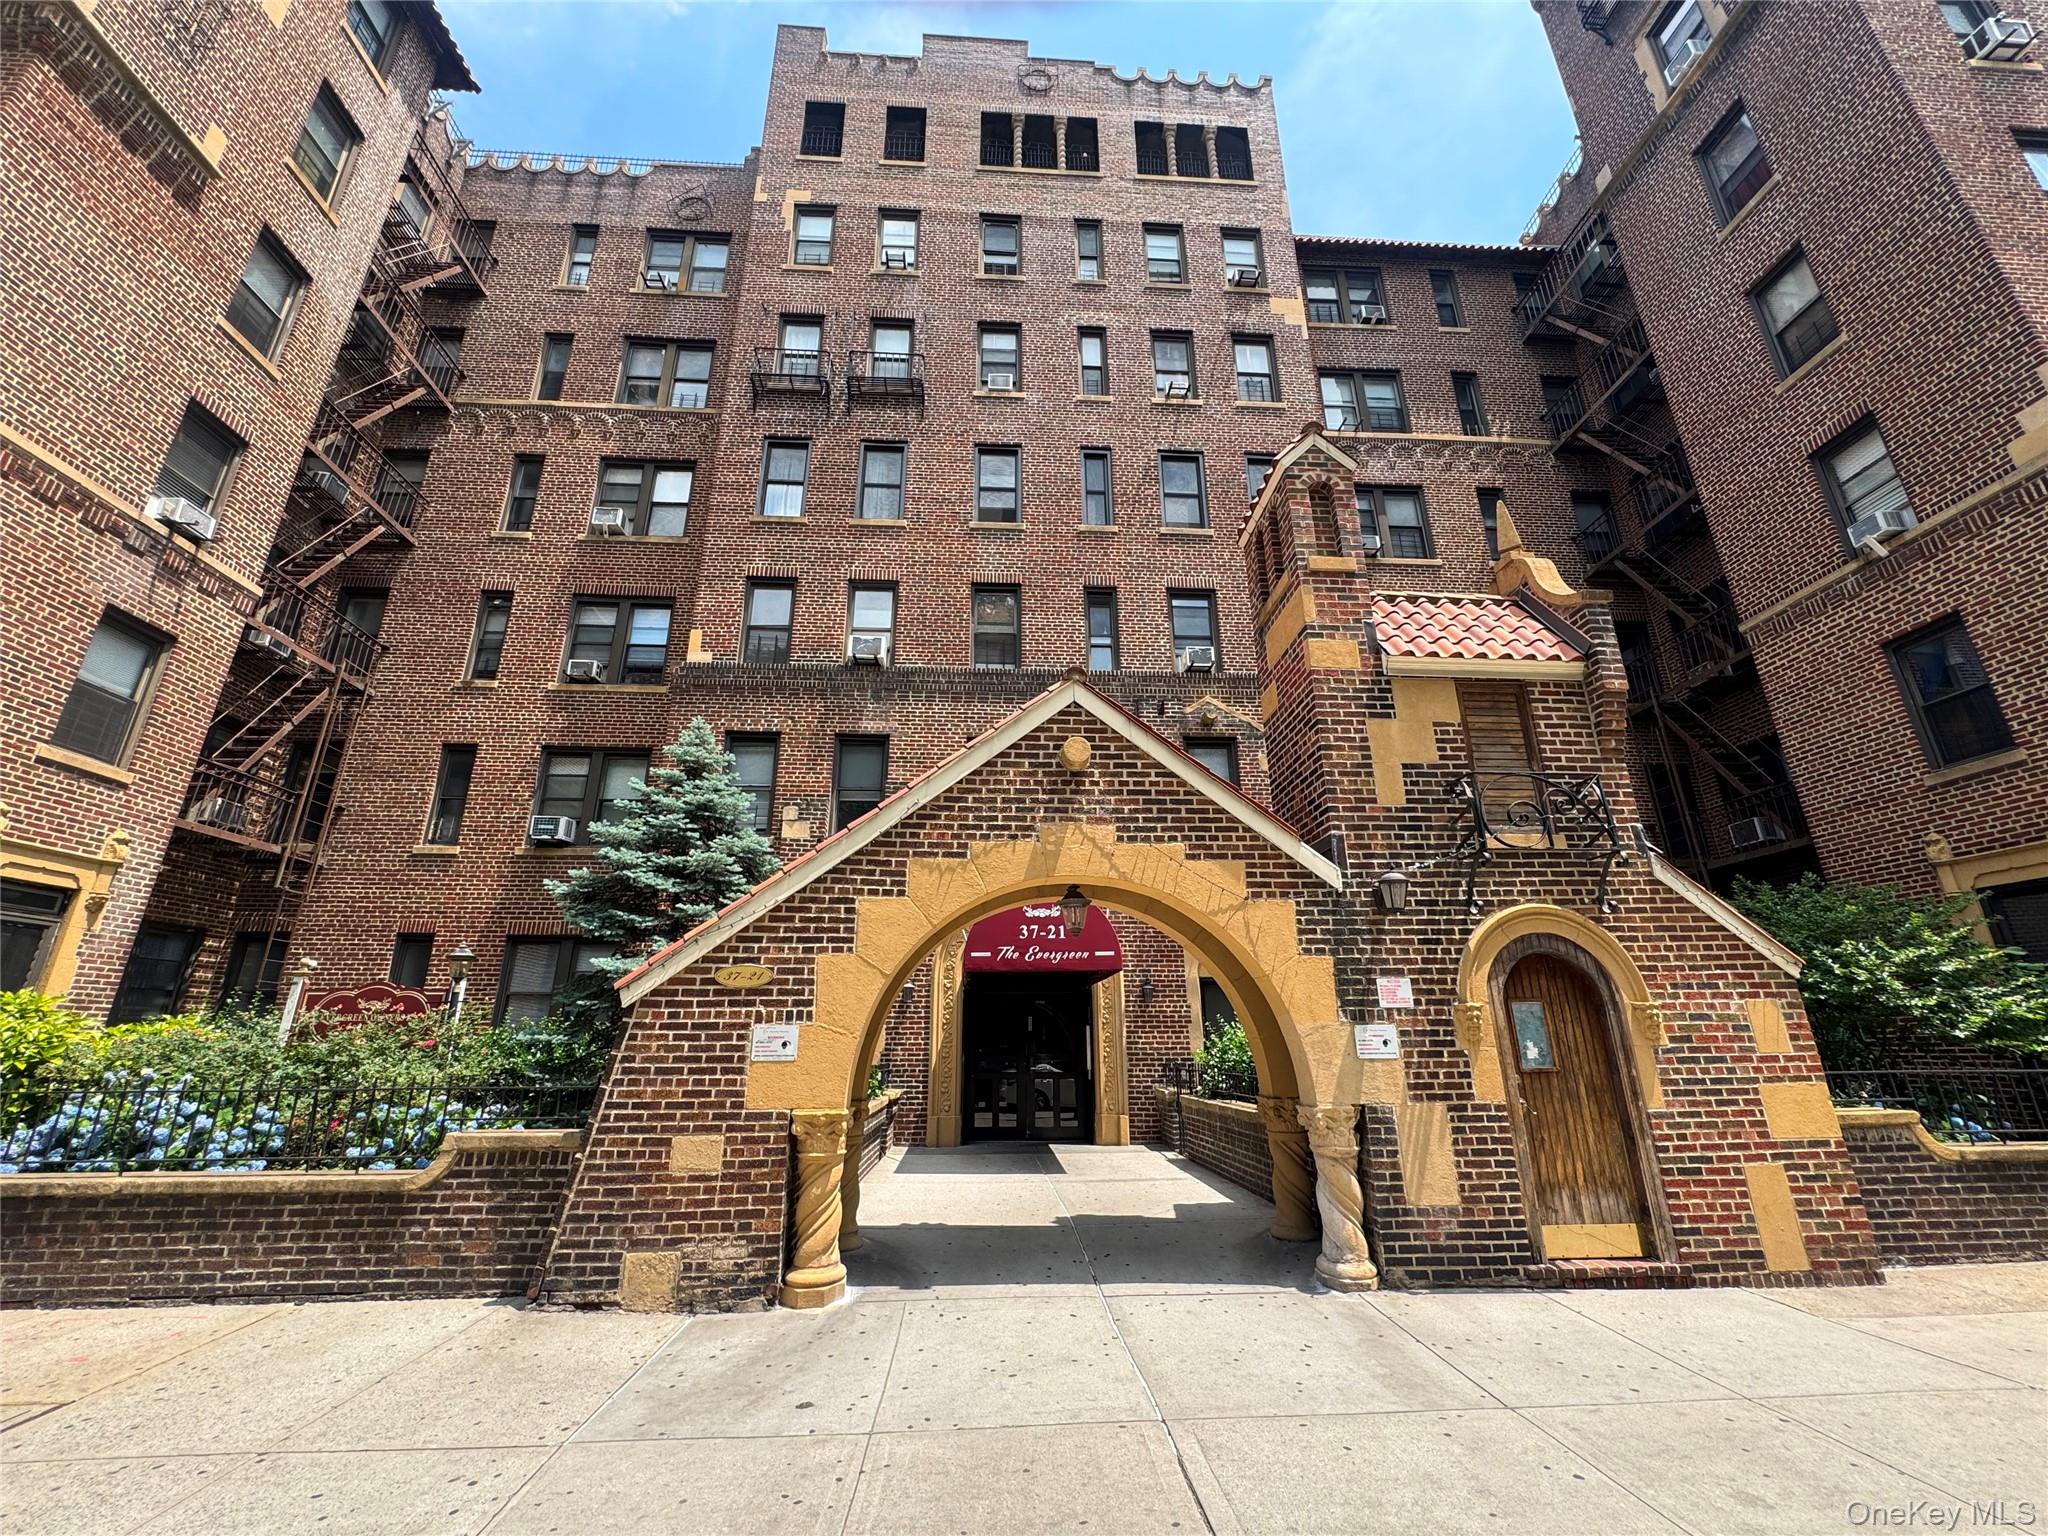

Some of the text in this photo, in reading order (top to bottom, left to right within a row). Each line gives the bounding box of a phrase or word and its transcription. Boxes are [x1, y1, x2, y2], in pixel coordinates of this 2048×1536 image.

[1019, 925, 1066, 939] 37-21
[996, 945, 1090, 964] The Evergreen
[723, 970, 764, 981] 37-21
